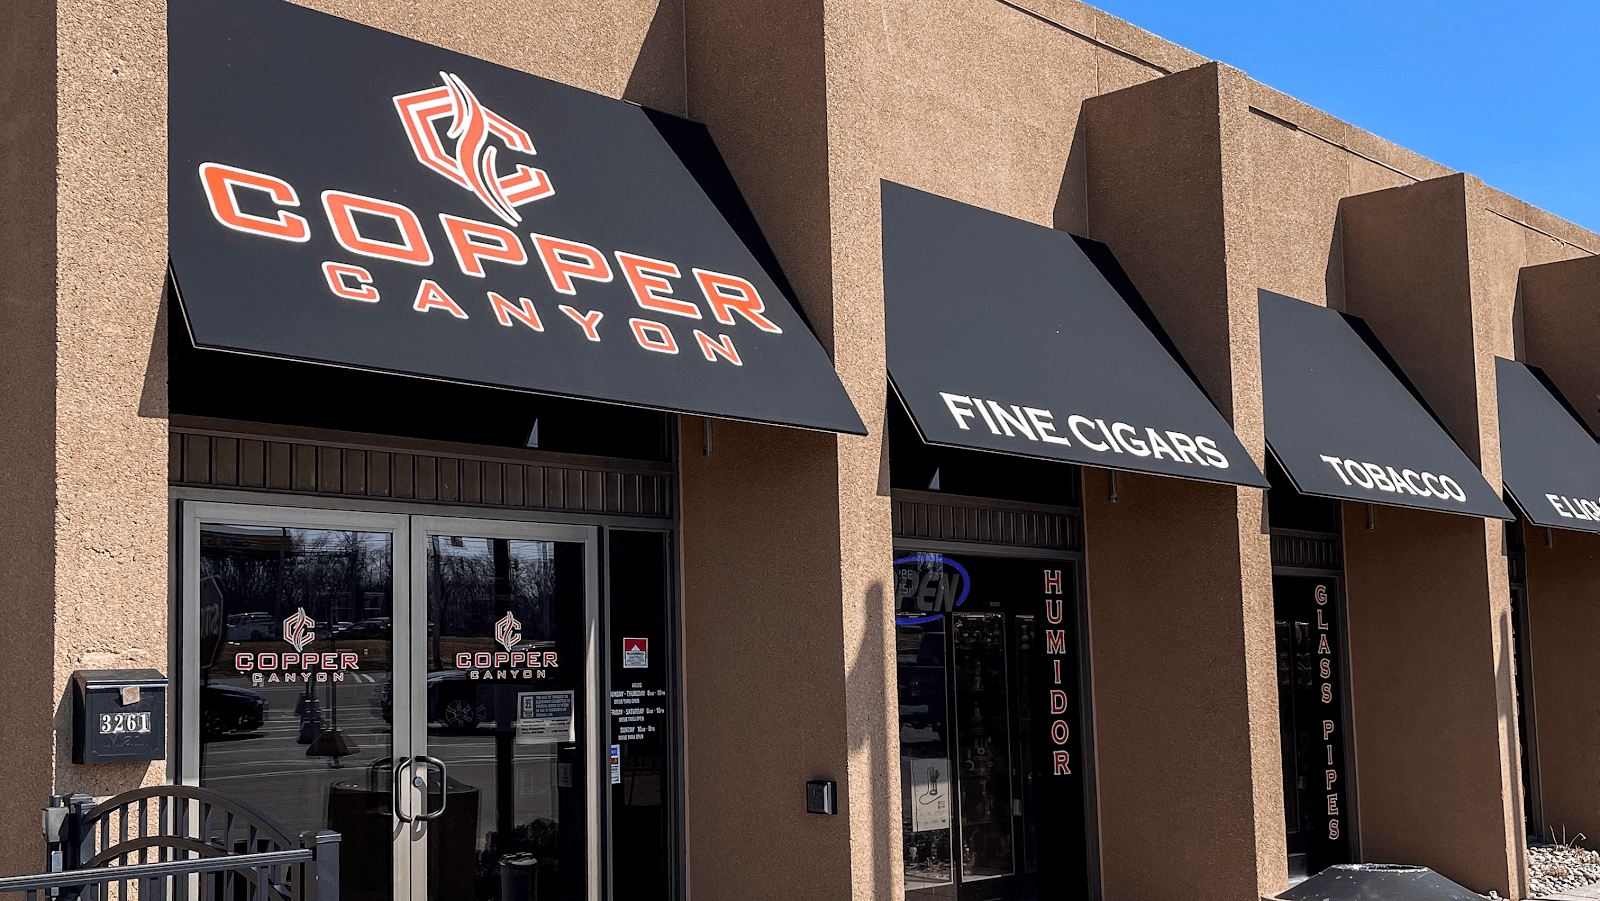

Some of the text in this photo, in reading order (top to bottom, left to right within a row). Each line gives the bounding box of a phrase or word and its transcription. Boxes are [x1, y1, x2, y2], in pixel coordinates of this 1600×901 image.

[199, 162, 783, 334] COPPER
[322, 261, 743, 366] CANYON
[939, 391, 1230, 469] FINE CIGARS
[1319, 453, 1467, 502] TOBACCO
[892, 570, 960, 612] PEN
[235, 653, 359, 670] COPPER
[252, 672, 344, 683] CANYON
[456, 652, 558, 668] COPPER
[470, 670, 546, 679] CANYON
[1044, 569, 1071, 775] HUMIDOR
[101, 713, 150, 733] 3261
[1315, 585, 1339, 840] GLASS PIPES
